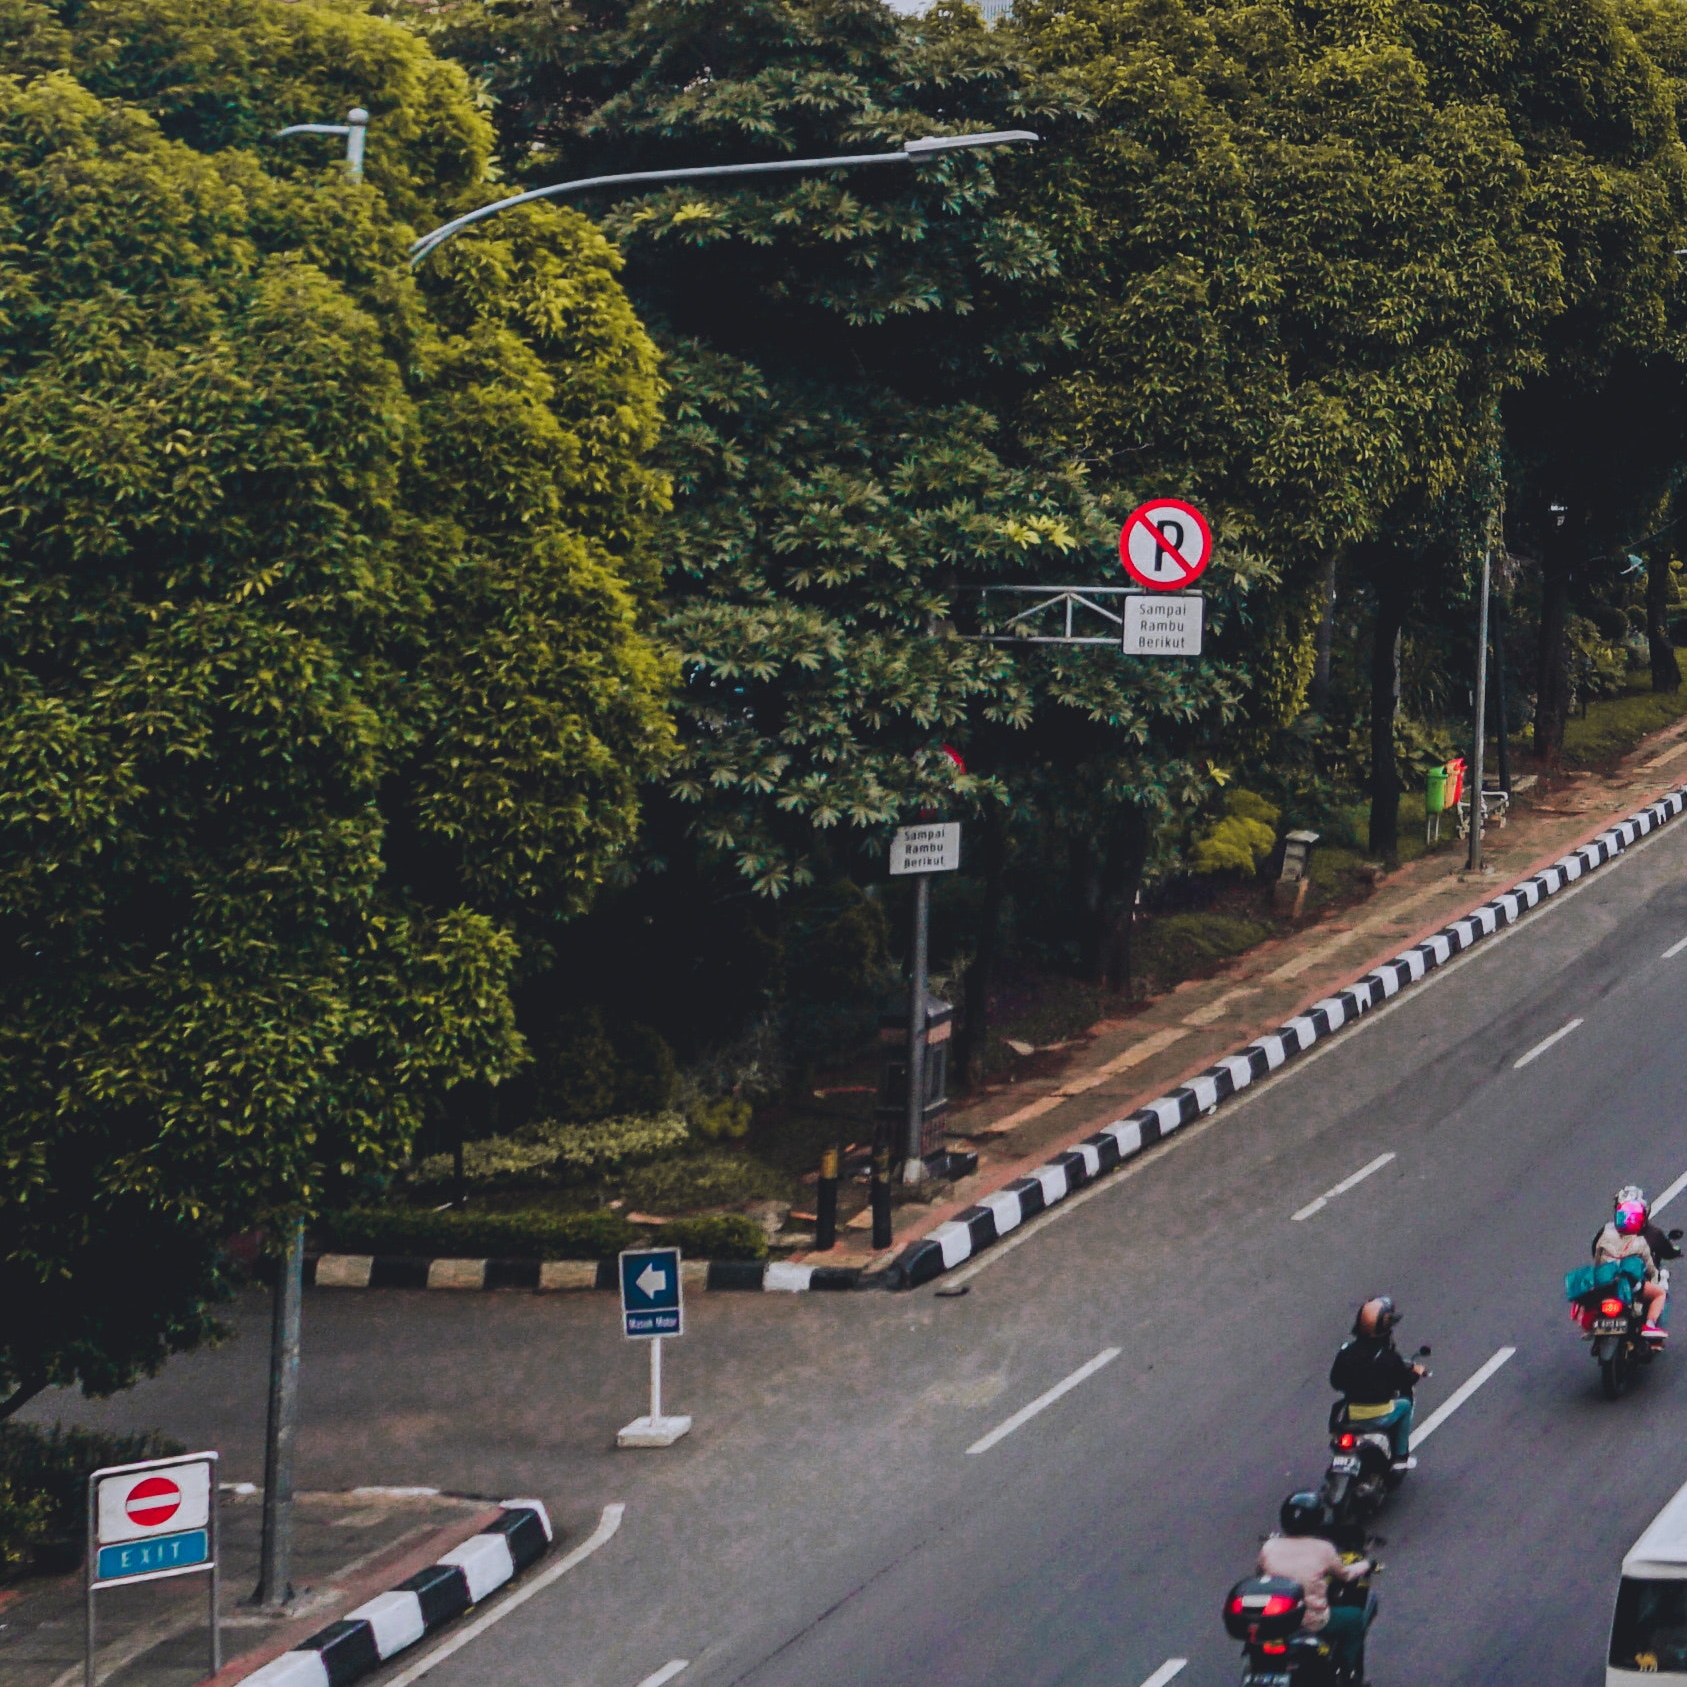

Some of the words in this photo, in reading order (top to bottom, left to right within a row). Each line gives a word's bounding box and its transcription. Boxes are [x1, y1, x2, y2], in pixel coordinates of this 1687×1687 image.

[1154, 520, 1184, 571] P
[1139, 603, 1187, 619] Sampai
[1140, 619, 1184, 632] Rambu
[1138, 636, 1185, 649] Berikut
[904, 828, 945, 841] Sampai
[905, 843, 944, 854] Rambu
[903, 856, 944, 869] Berikut
[121, 1540, 181, 1568] EXIT
